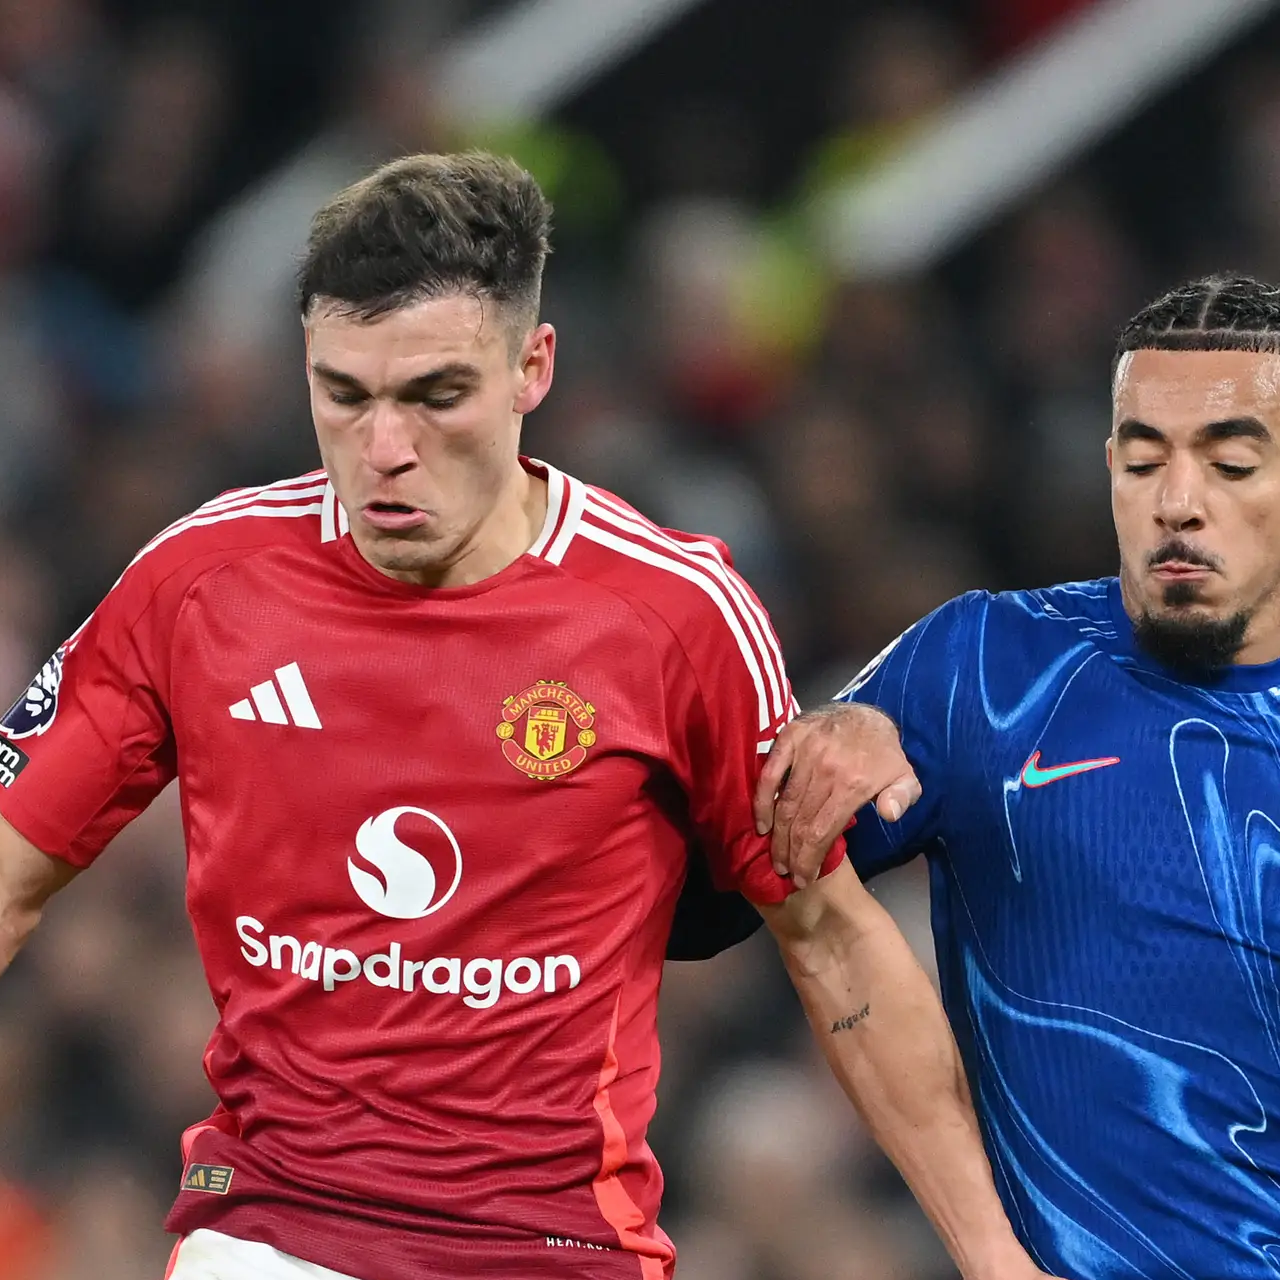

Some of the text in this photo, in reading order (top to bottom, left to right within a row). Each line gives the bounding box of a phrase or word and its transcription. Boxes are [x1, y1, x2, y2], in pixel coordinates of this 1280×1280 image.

[510, 687, 588, 722] MANCHESTER
[516, 755, 571, 772] UNITED
[235, 915, 581, 1009] Snapdragon
